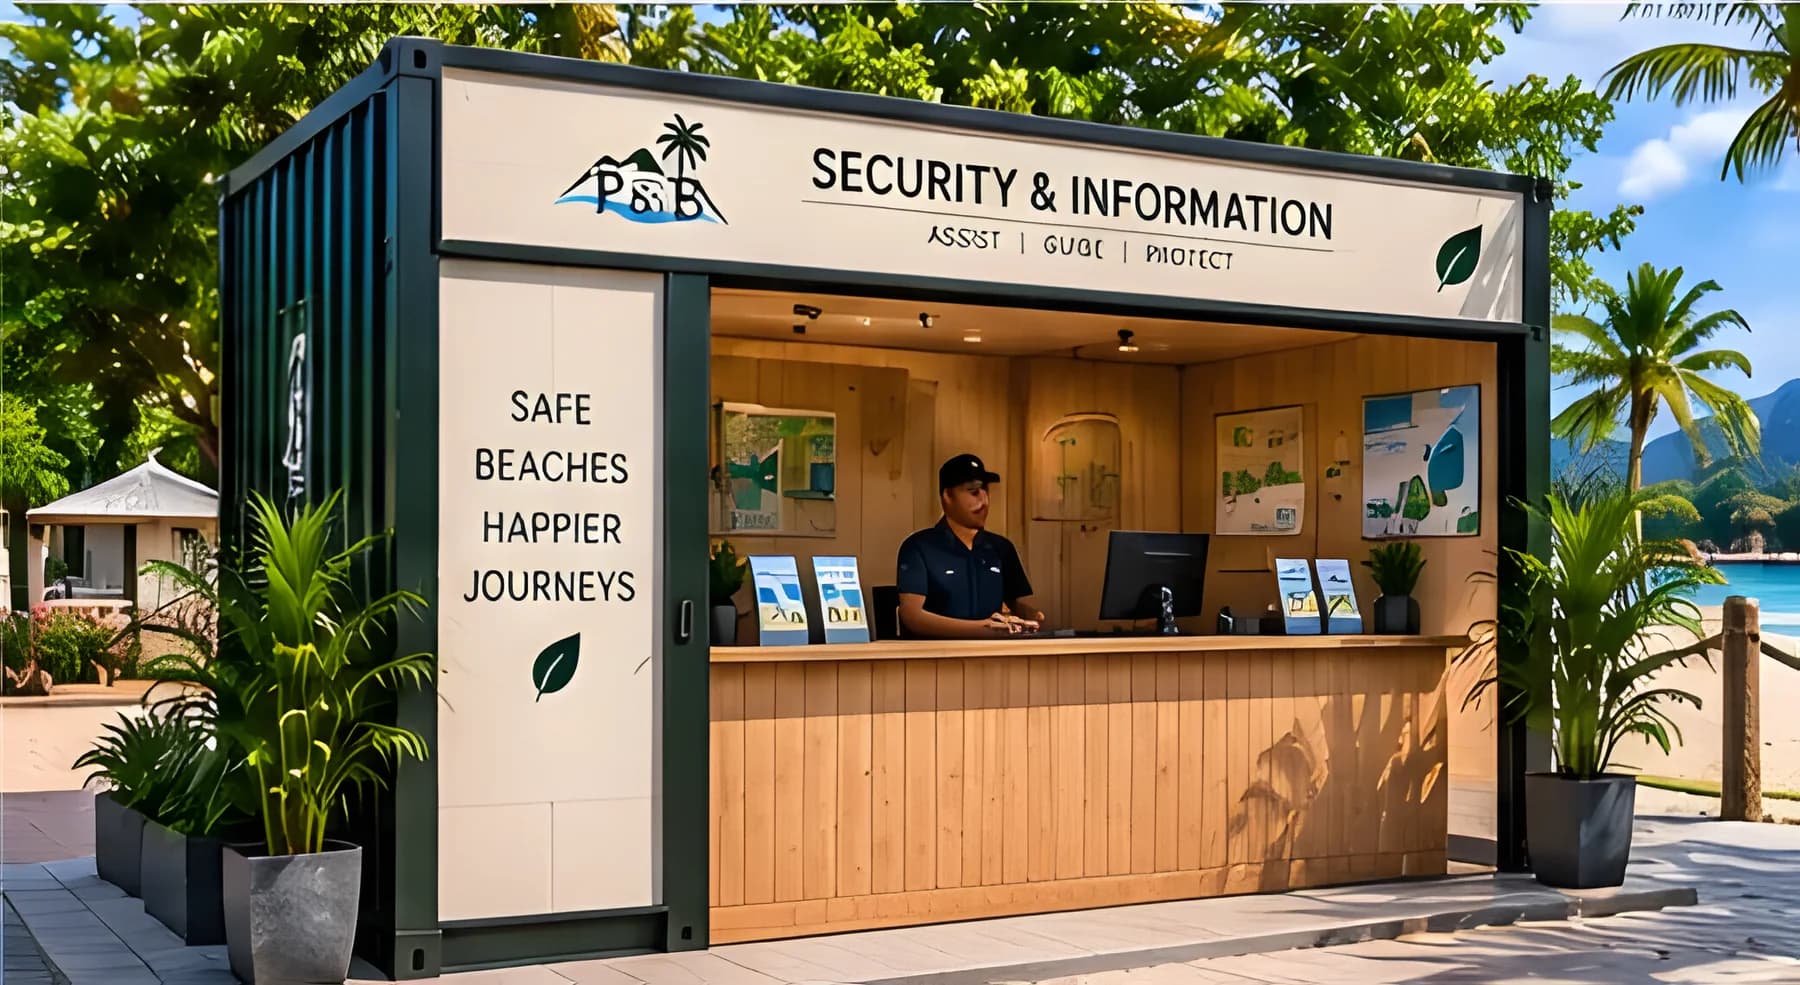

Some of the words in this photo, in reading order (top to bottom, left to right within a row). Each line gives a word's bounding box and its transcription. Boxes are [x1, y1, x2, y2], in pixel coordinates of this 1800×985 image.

[812, 147, 1019, 208] SECURITY
[1030, 171, 1058, 213] &
[1072, 175, 1333, 241] INFORMATION
[511, 390, 592, 425] SAFE
[475, 447, 629, 484] BEACHES
[482, 511, 622, 545] HAPPIER
[463, 569, 636, 603] JOURNEYS
